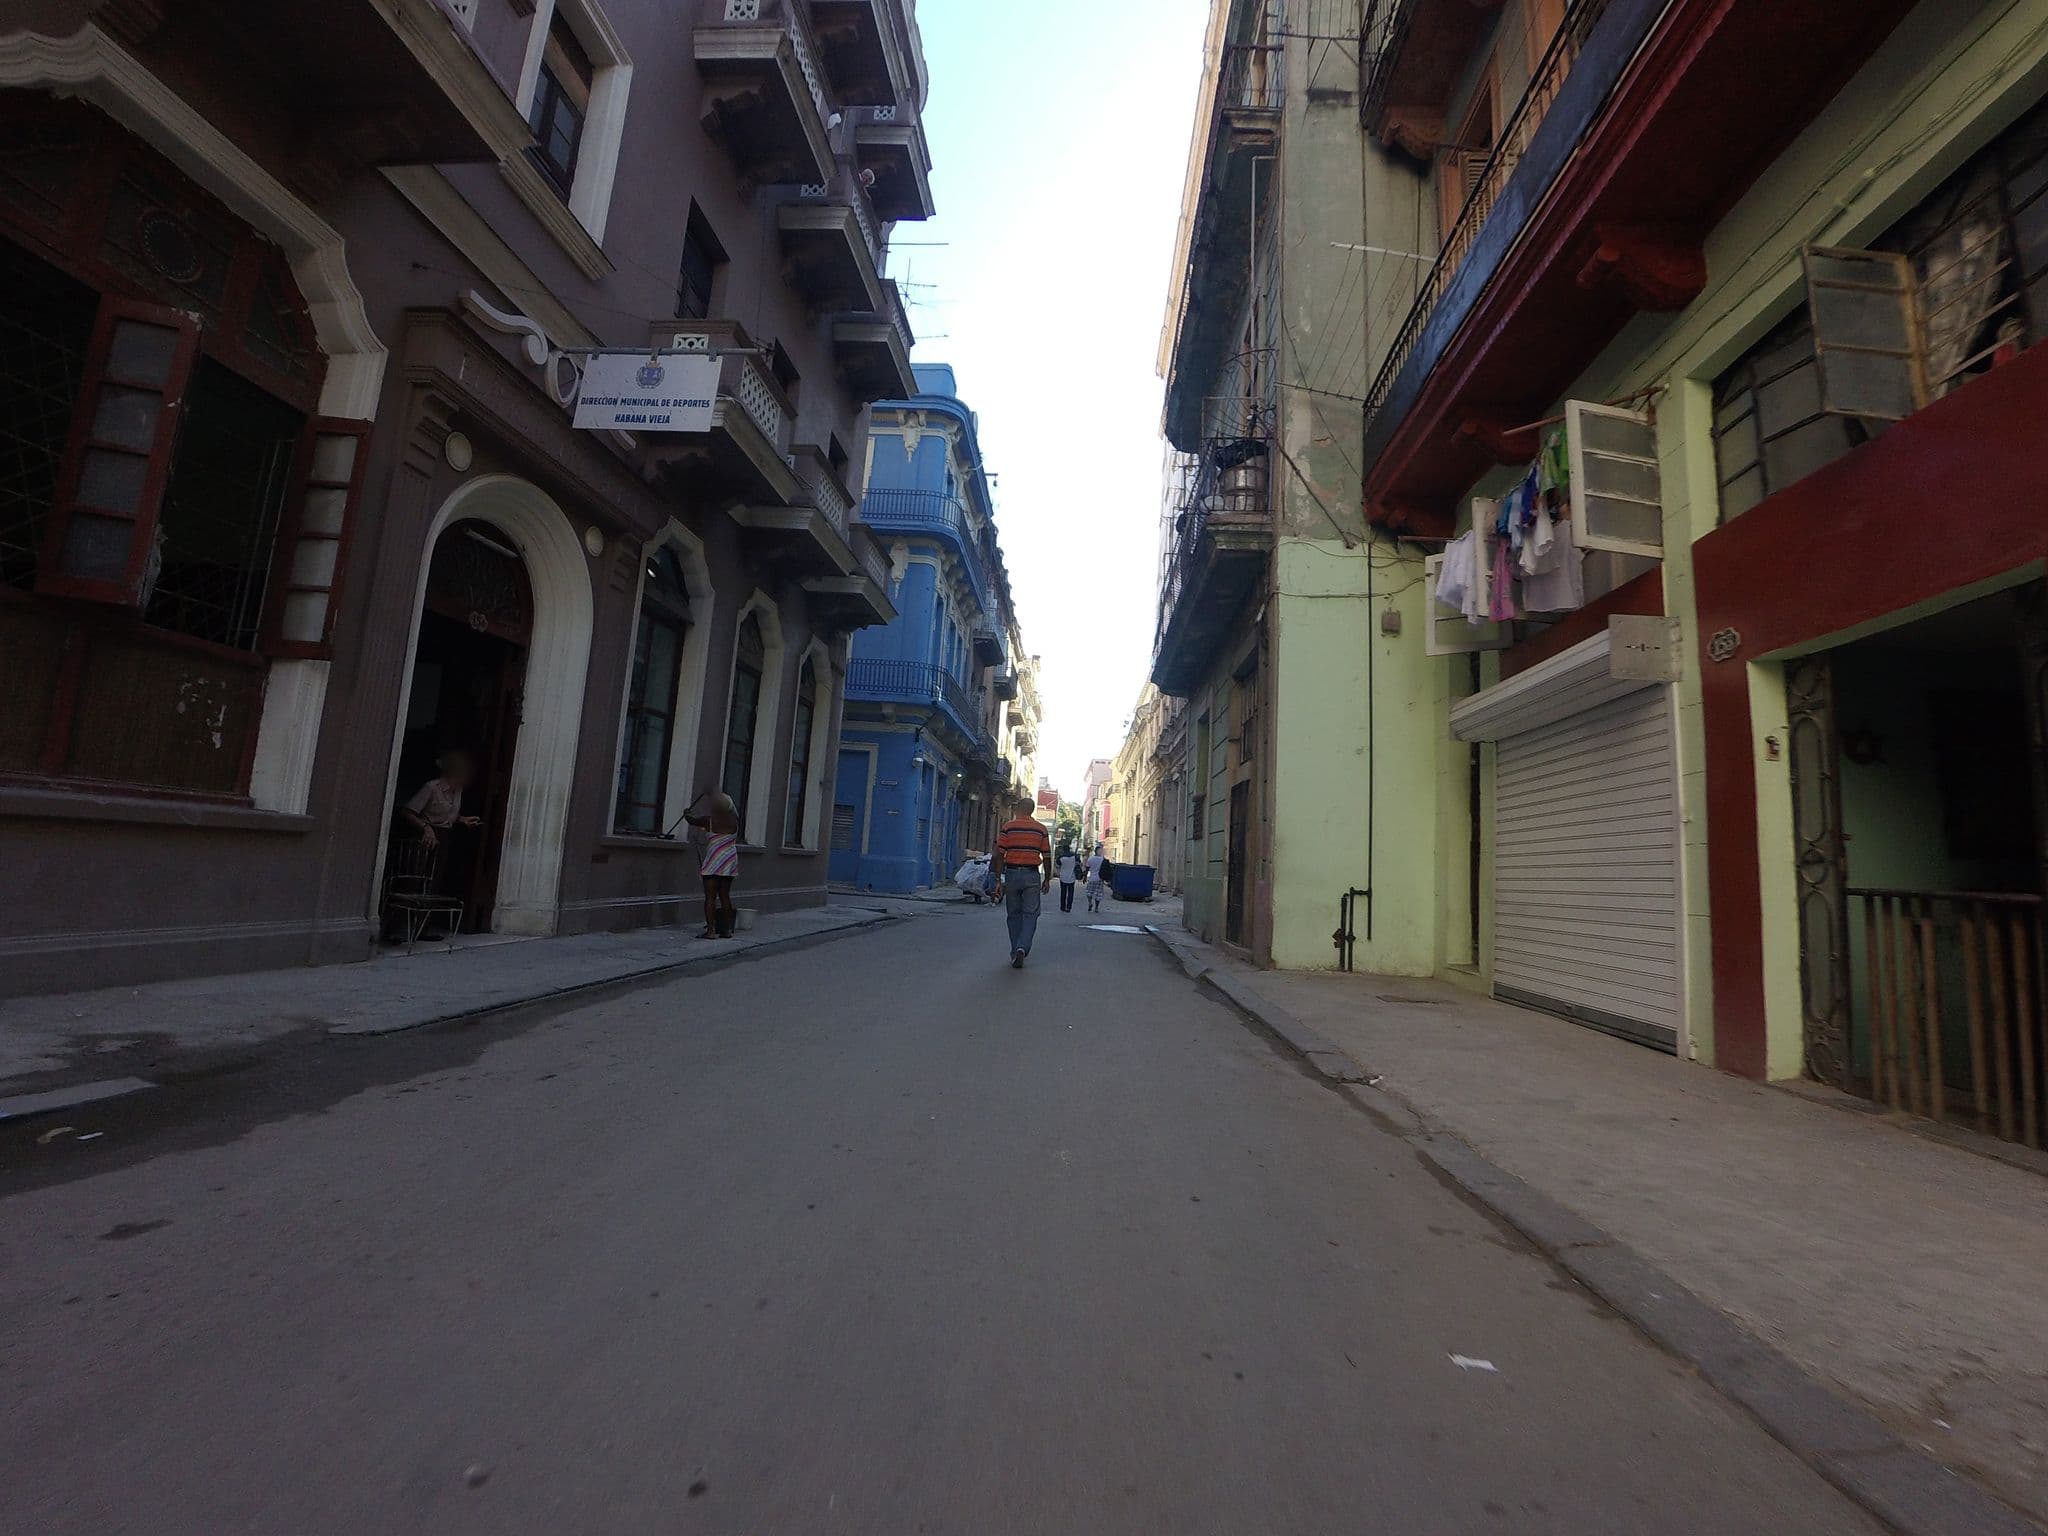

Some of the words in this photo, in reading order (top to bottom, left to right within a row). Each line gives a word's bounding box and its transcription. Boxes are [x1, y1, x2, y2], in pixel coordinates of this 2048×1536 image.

[620, 398, 659, 407] MUNICIPAL
[661, 399, 670, 407] DE
[673, 399, 710, 408] DEPORTES
[614, 414, 647, 423] HABANA
[649, 415, 671, 424] VIEJA
